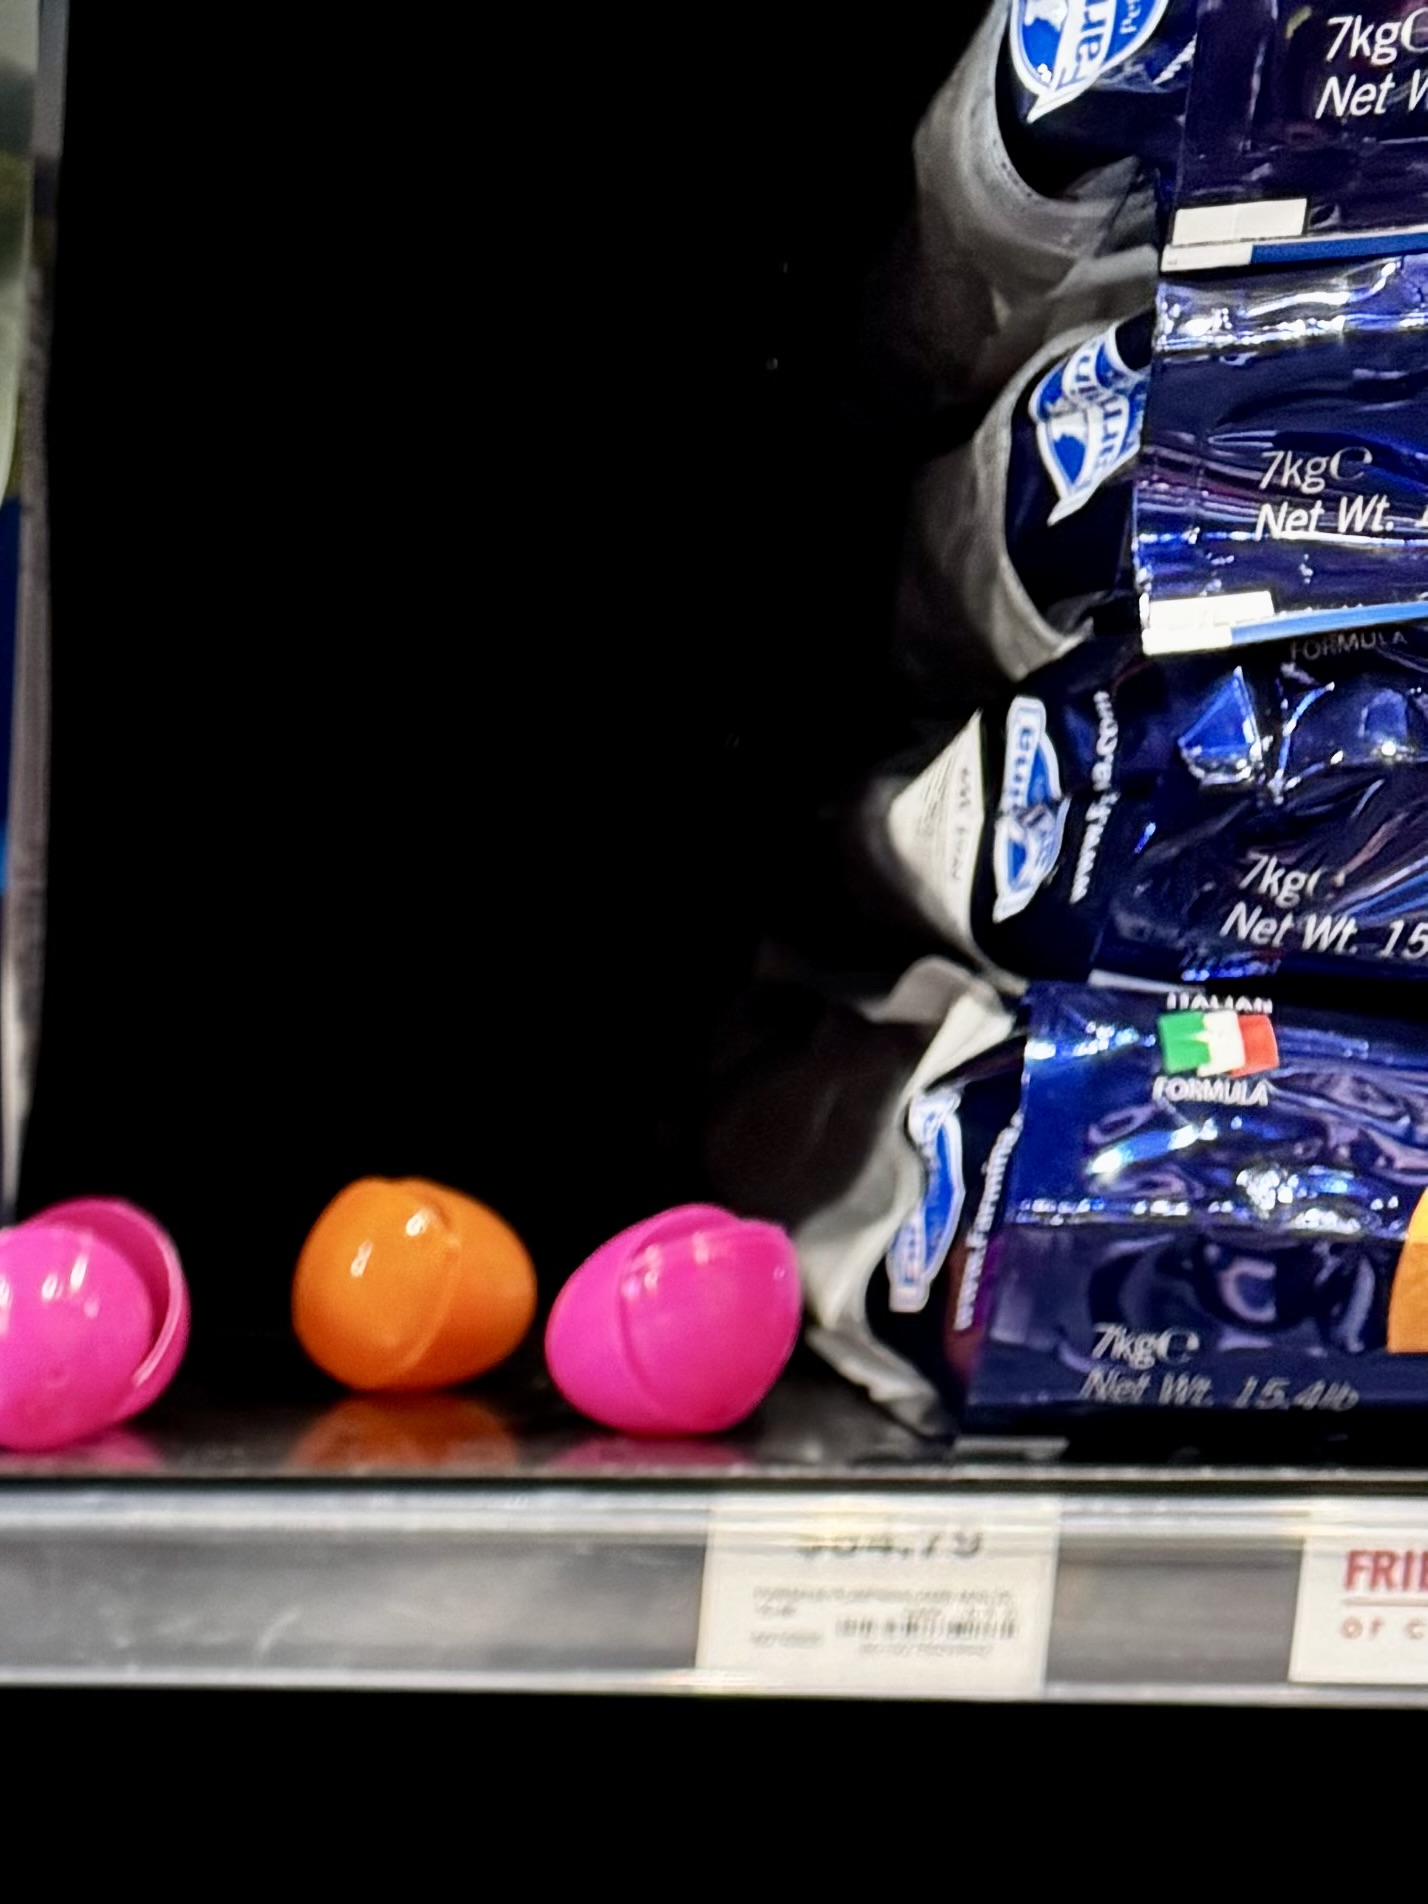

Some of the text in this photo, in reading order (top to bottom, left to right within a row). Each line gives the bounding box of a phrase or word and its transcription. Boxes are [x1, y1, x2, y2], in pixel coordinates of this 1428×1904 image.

[1315, 72, 1396, 119] Net
[1255, 494, 1393, 541] Net Wt.
[1219, 901, 1294, 948] Net
[1301, 912, 1359, 955] Wt.
[1151, 1075, 1272, 1107] FORMULA
[1079, 1366, 1150, 1403] Net
[1234, 1374, 1359, 1412] 15.4lb
